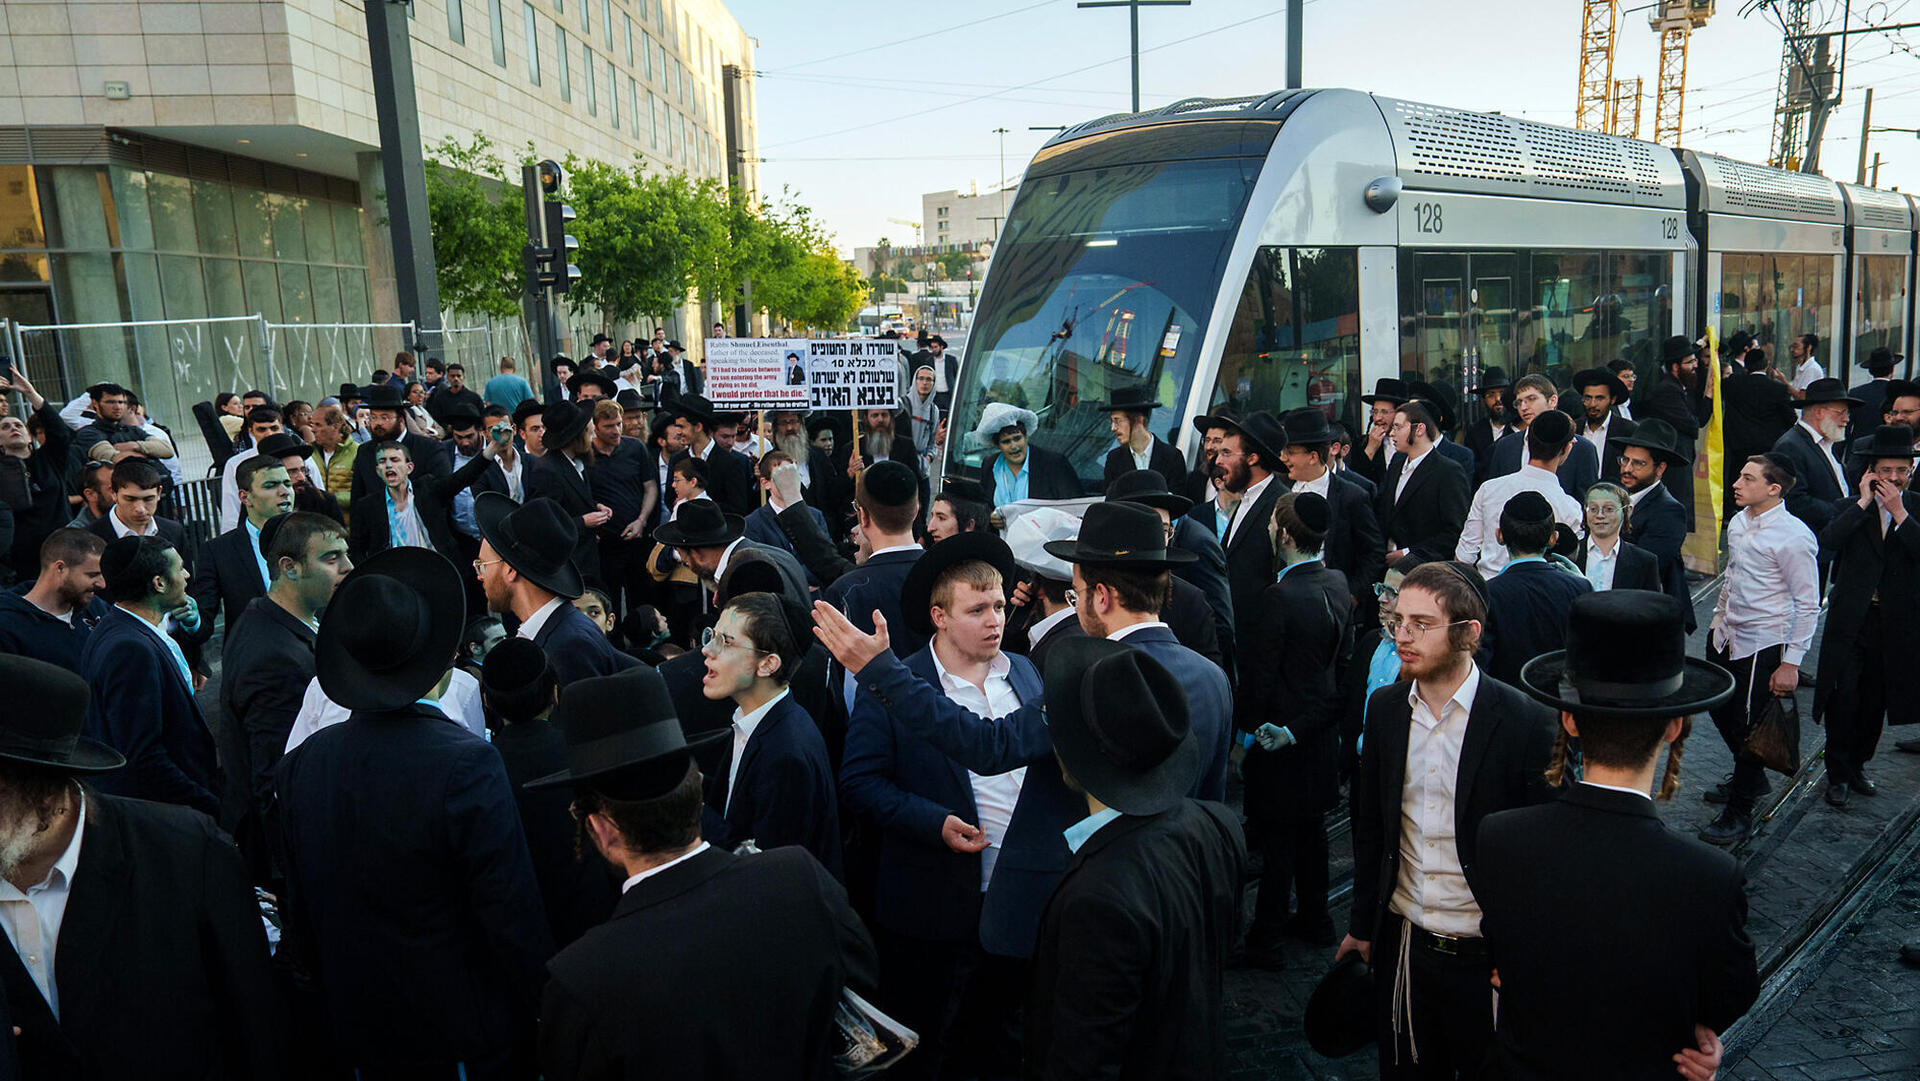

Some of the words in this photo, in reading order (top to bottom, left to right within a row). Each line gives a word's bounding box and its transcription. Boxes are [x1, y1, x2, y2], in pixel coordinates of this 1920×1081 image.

[1414, 203, 1443, 234] 128
[1661, 217, 1678, 240] 128
[811, 343, 847, 355] החטופים
[850, 343, 862, 355] את
[866, 343, 894, 355] שחררו
[710, 357, 738, 365] speaking
[831, 359, 844, 368] 10
[847, 357, 876, 368] מכלא
[811, 371, 840, 384] ישרתו
[843, 370, 856, 383] לא
[711, 391, 715, 399] I
[716, 390, 739, 398] would
[740, 390, 762, 399] prefer
[764, 390, 779, 398] that
[780, 390, 789, 398] he
[812, 387, 851, 406] האויב
[857, 386, 895, 406] בצבא
